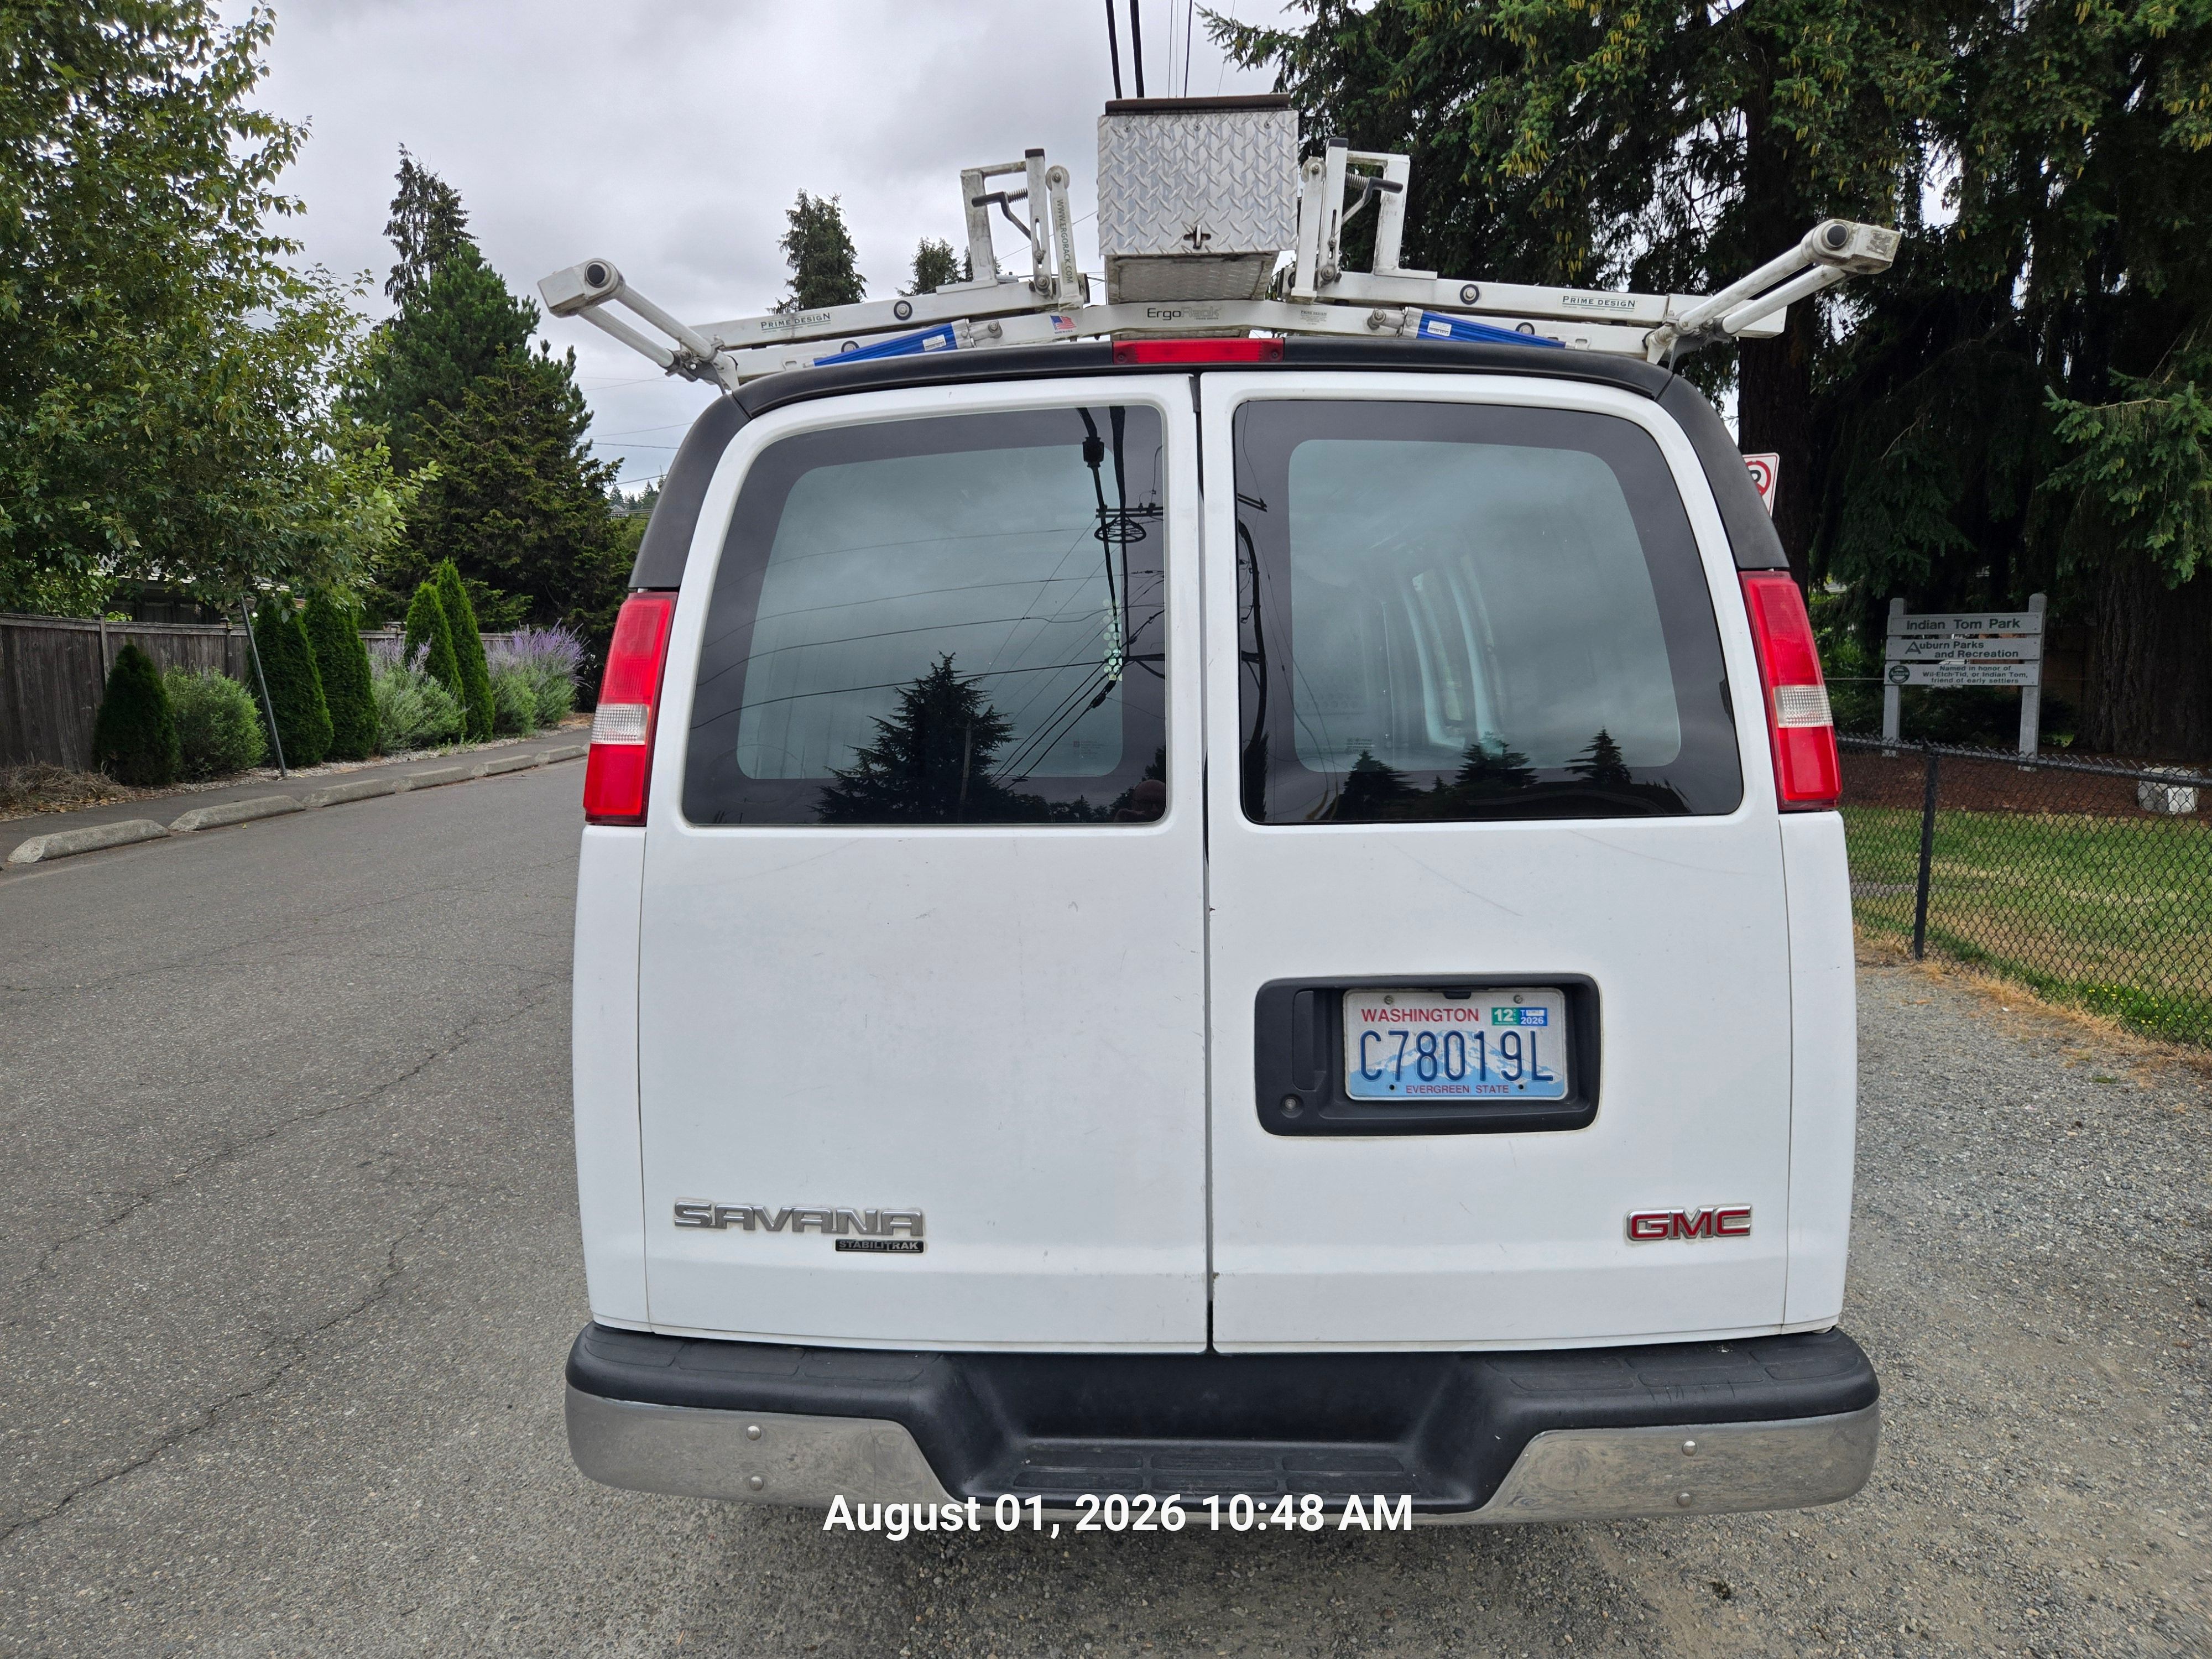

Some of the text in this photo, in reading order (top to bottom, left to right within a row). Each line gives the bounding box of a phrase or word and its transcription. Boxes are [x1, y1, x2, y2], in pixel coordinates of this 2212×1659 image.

[1057, 199, 1073, 284] WWW.ERGORACK.COM
[1562, 295, 1635, 307] PRIME DESIGN
[760, 320, 791, 329] PRIME
[794, 312, 831, 324] DESIGN
[1906, 618, 2021, 630] Indian Tom Park
[1905, 641, 1950, 654] Auburn
[1958, 649, 2018, 658] Recreation
[1361, 1008, 1479, 1022] WASHINGTON
[1494, 1009, 1514, 1021] 12
[1360, 1030, 1554, 1081] C78019L
[1406, 1085, 1509, 1094] EVERGREEN STATE
[674, 1201, 924, 1237] SAVANA
[1626, 1206, 1751, 1241] GMC
[838, 1240, 920, 1251] STABILITRAK
